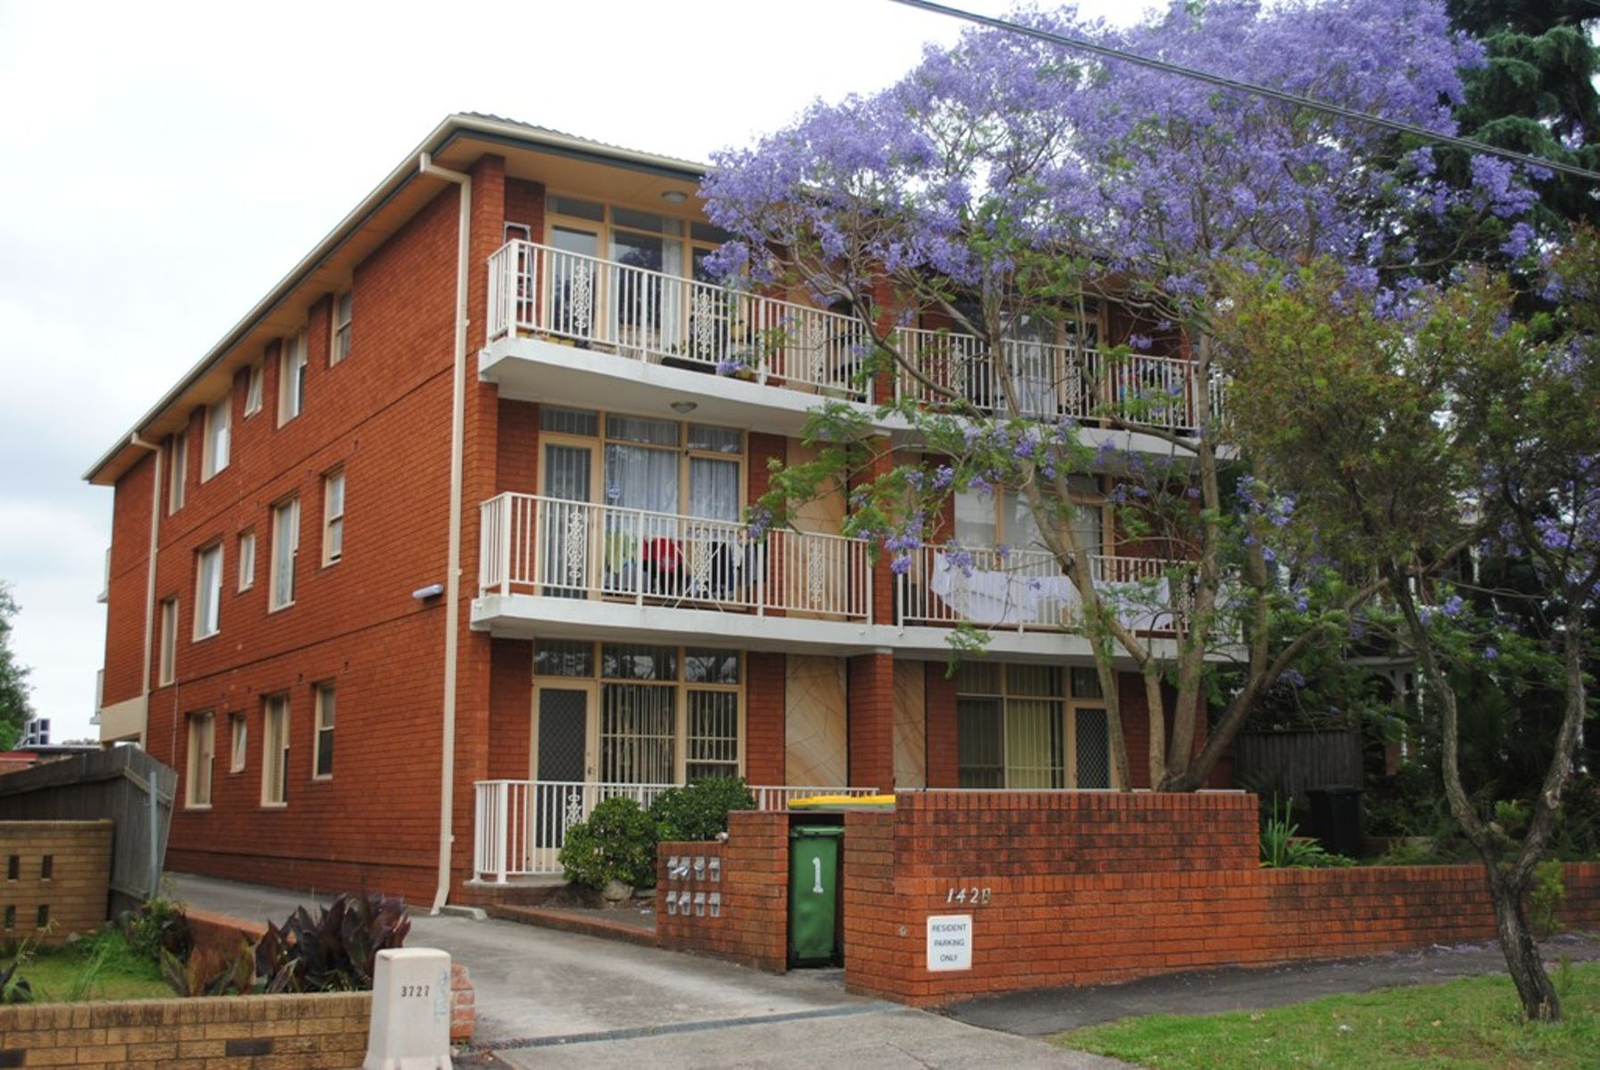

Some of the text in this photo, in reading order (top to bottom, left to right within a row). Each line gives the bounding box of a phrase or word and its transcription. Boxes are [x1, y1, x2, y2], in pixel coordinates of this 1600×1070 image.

[812, 856, 824, 894] 1
[931, 924, 967, 933] RESIDENT
[933, 939, 965, 947] PARKING
[940, 954, 958, 962] ONLY
[400, 985, 430, 998] 3727
